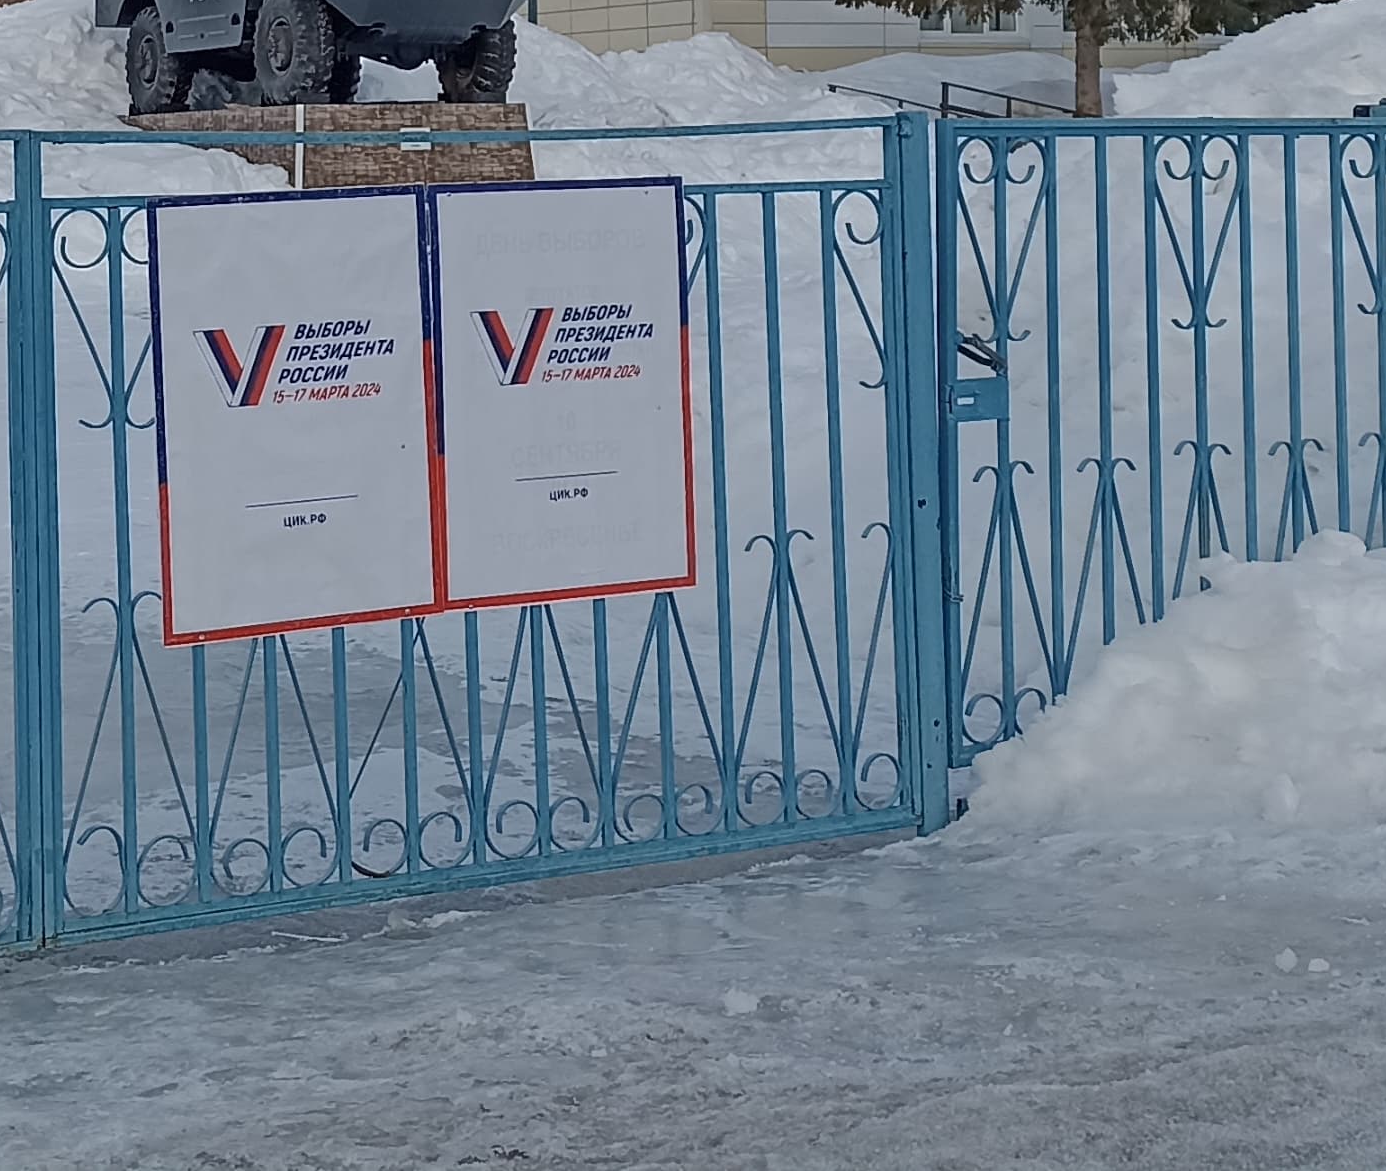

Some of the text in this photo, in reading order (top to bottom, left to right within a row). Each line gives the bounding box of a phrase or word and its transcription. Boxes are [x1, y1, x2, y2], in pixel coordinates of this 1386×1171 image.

[561, 304, 632, 323] ВЫБОРЫ
[293, 319, 371, 340] ВЫБОРЫ
[554, 323, 654, 344] ПРЕЗИДЕНТА
[286, 338, 395, 362] ПРЕЗИДЕНТА
[547, 346, 611, 364] РОССИИ
[278, 364, 349, 384] РОССИИ
[575, 366, 612, 380] МАРТА
[613, 364, 641, 378] 2024
[309, 385, 350, 401] МАРТА
[351, 382, 381, 398] 2024
[549, 487, 589, 502] ЦИК.РФ
[283, 512, 327, 528] ЦИК.РФ
